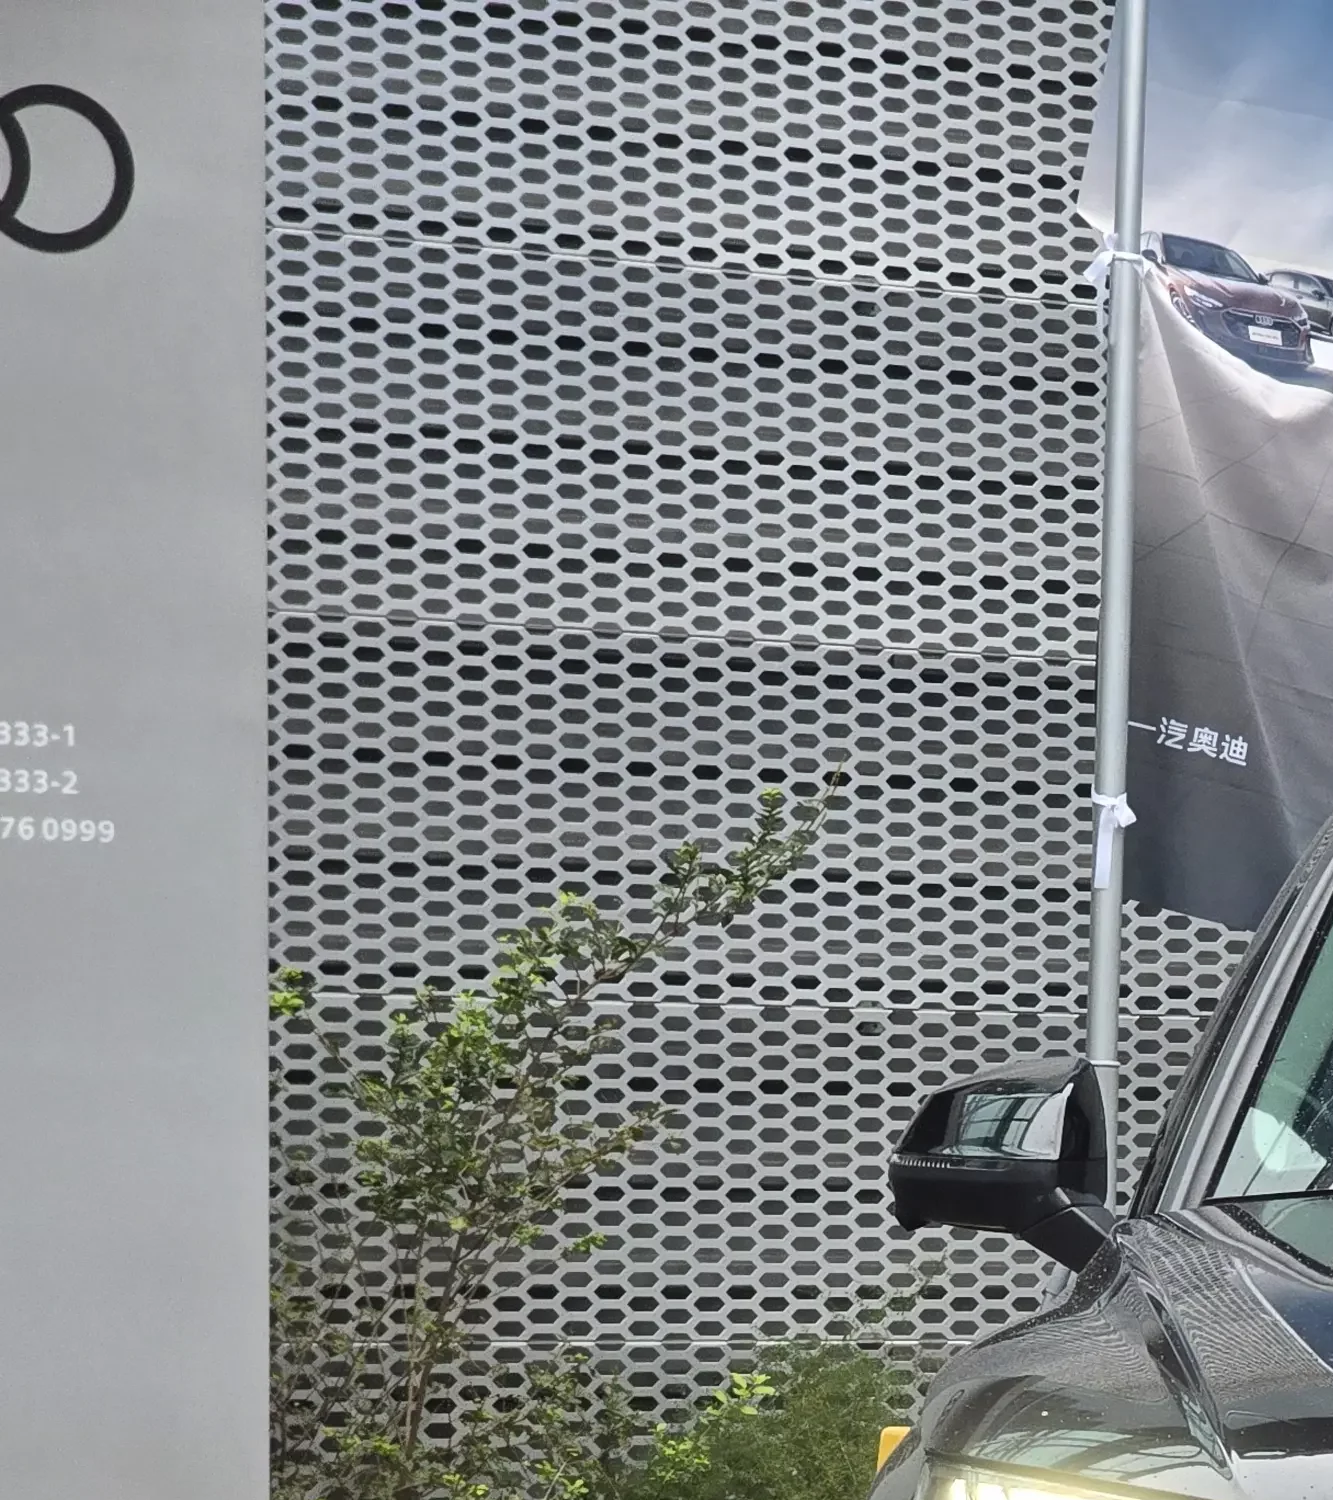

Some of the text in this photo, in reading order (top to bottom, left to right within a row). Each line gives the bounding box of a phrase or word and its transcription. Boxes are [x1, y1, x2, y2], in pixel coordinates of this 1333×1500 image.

[1127, 716, 1249, 767] 一汽奥迪
[0, 815, 115, 843] 76 0999
